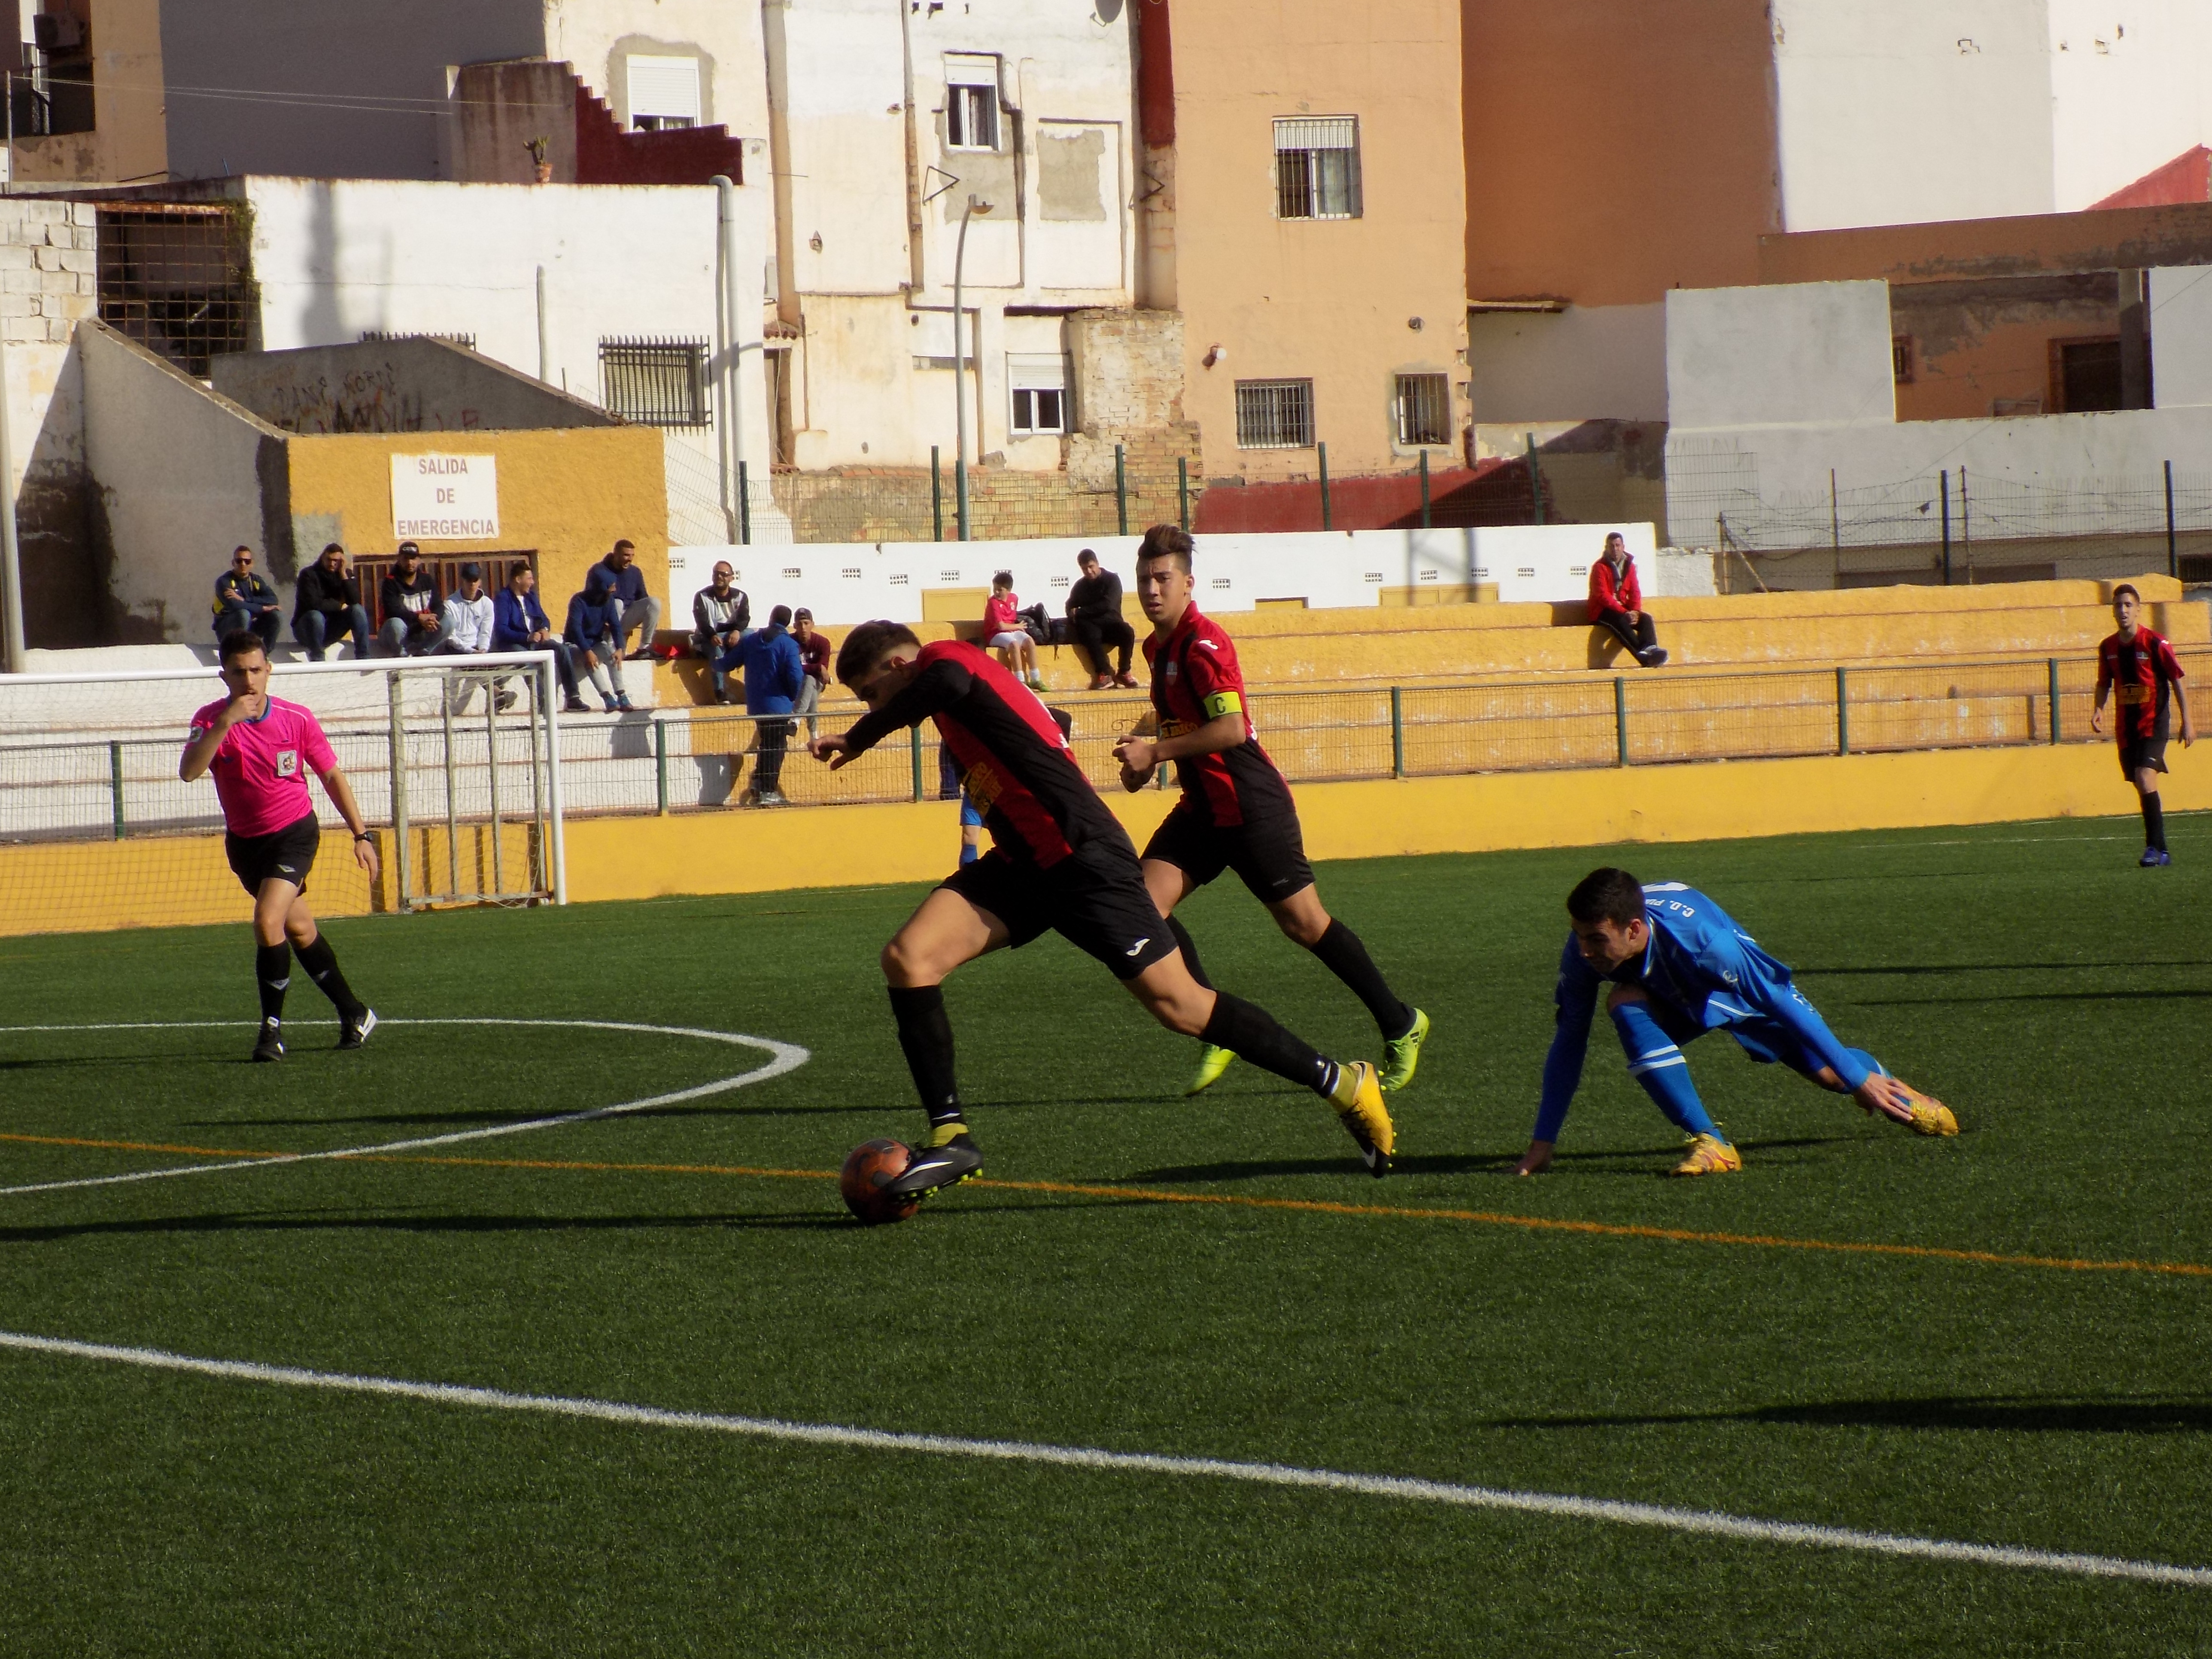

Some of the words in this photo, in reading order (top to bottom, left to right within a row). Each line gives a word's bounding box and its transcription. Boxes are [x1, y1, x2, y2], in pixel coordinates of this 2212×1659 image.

[419, 458, 468, 474] SALIDA
[436, 488, 455, 504] DE
[397, 519, 495, 535] EMERGENCIA
[1214, 696, 1226, 714] C
[1669, 900, 1695, 918] C.D.
